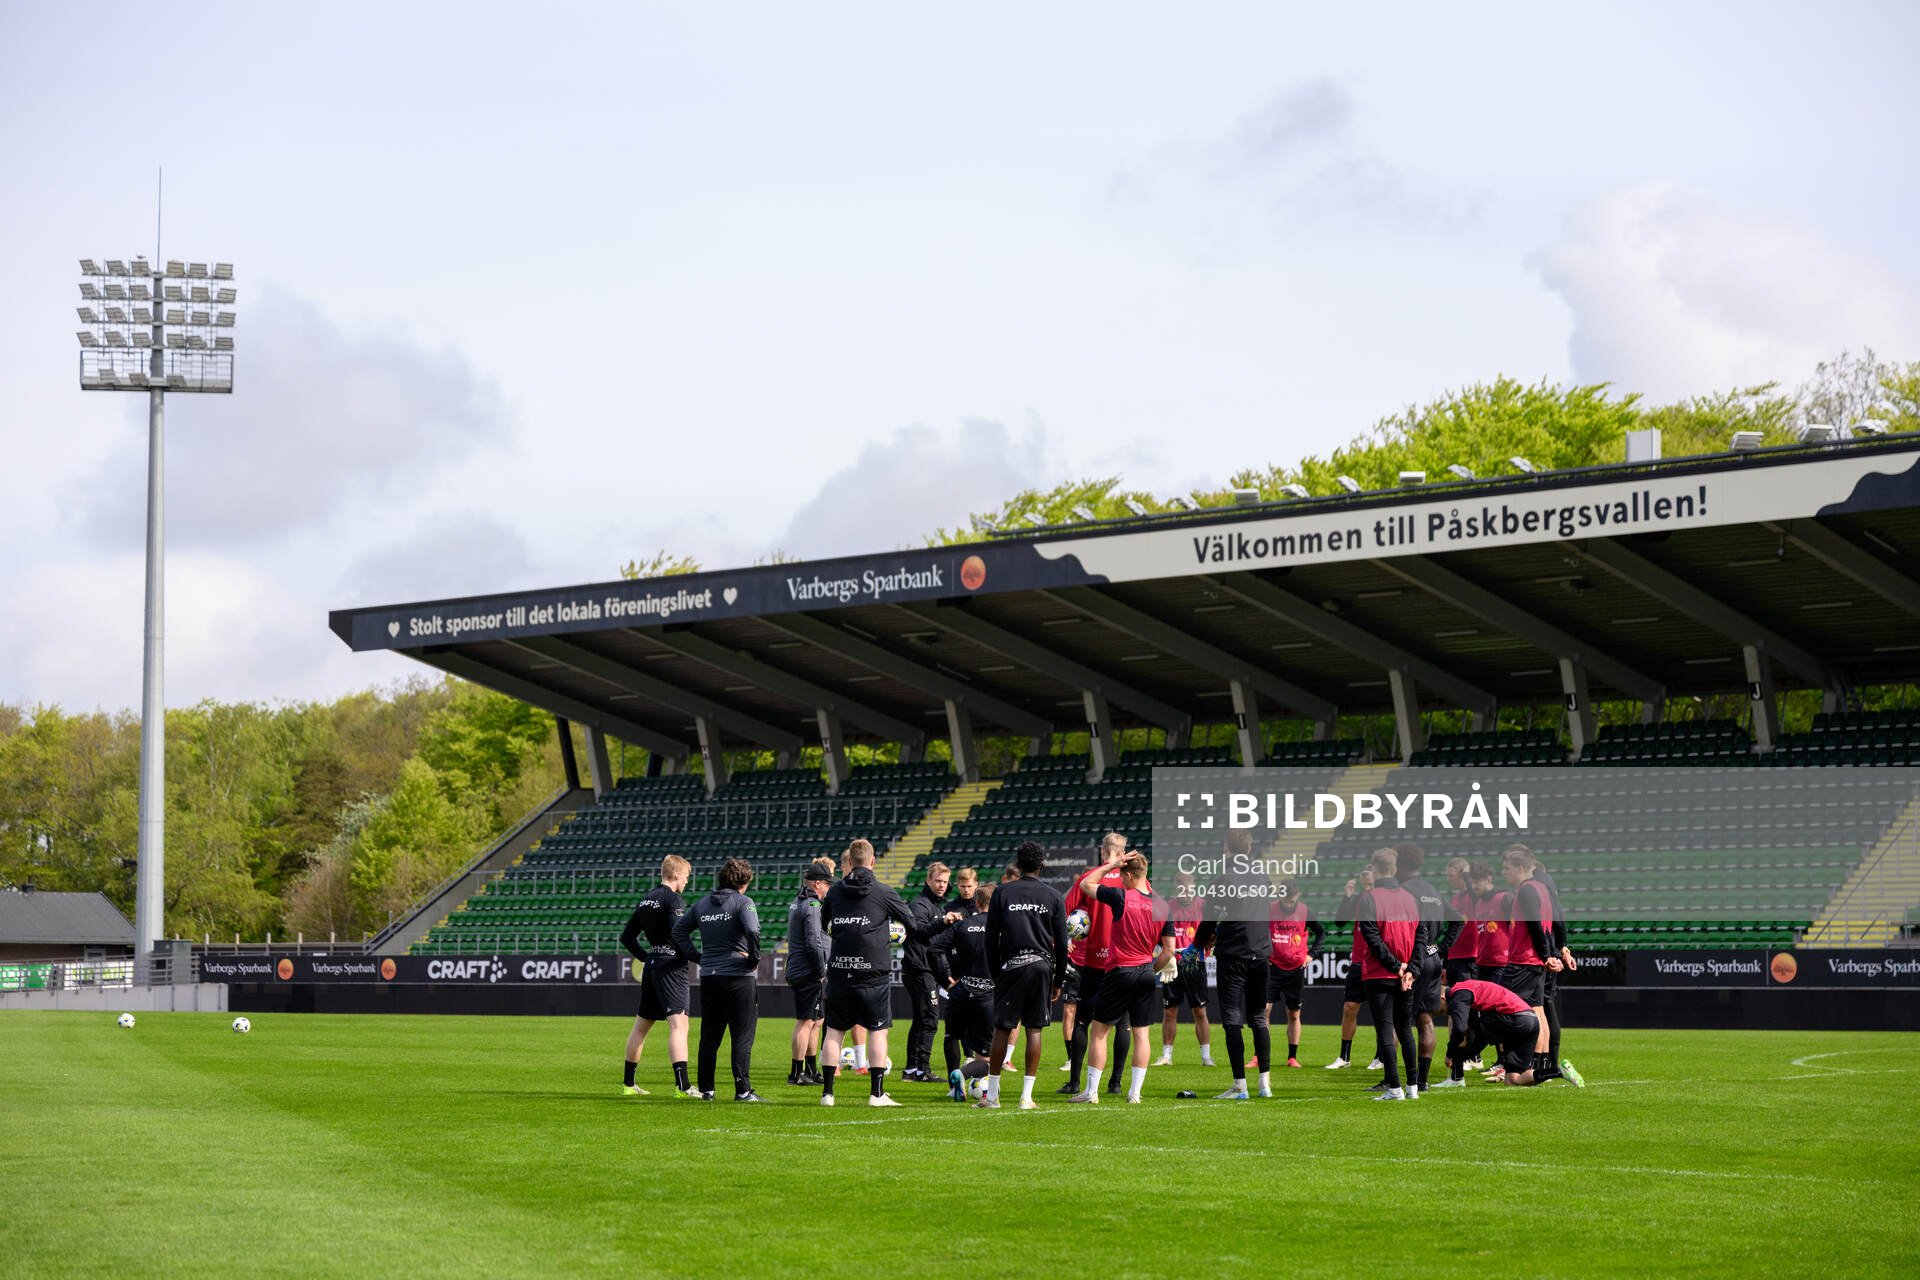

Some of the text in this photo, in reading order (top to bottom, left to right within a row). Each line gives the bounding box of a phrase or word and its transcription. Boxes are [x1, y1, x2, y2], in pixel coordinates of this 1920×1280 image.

[1193, 485, 1707, 564] Välkommen till Påskbergsvallen!
[786, 564, 943, 602] Varbergs Sparbank
[409, 589, 712, 637] Stolt sponsor till det lokala föreningslivet
[1009, 904, 1040, 912] CRAFT
[700, 913, 724, 922] CRAFT
[833, 917, 862, 925] CRAFT
[205, 963, 272, 975] Varbergs Sparbank
[312, 963, 376, 975] Varbergs Sparbank
[831, 962, 872, 970] WELLNESS
[1585, 957, 1609, 967] 2002
[1655, 959, 1761, 976] Varbergs Sparbank
[1829, 959, 1920, 977] Varbergs Sparb
[427, 960, 490, 979] CRAFT
[521, 961, 585, 979] CRAFT
